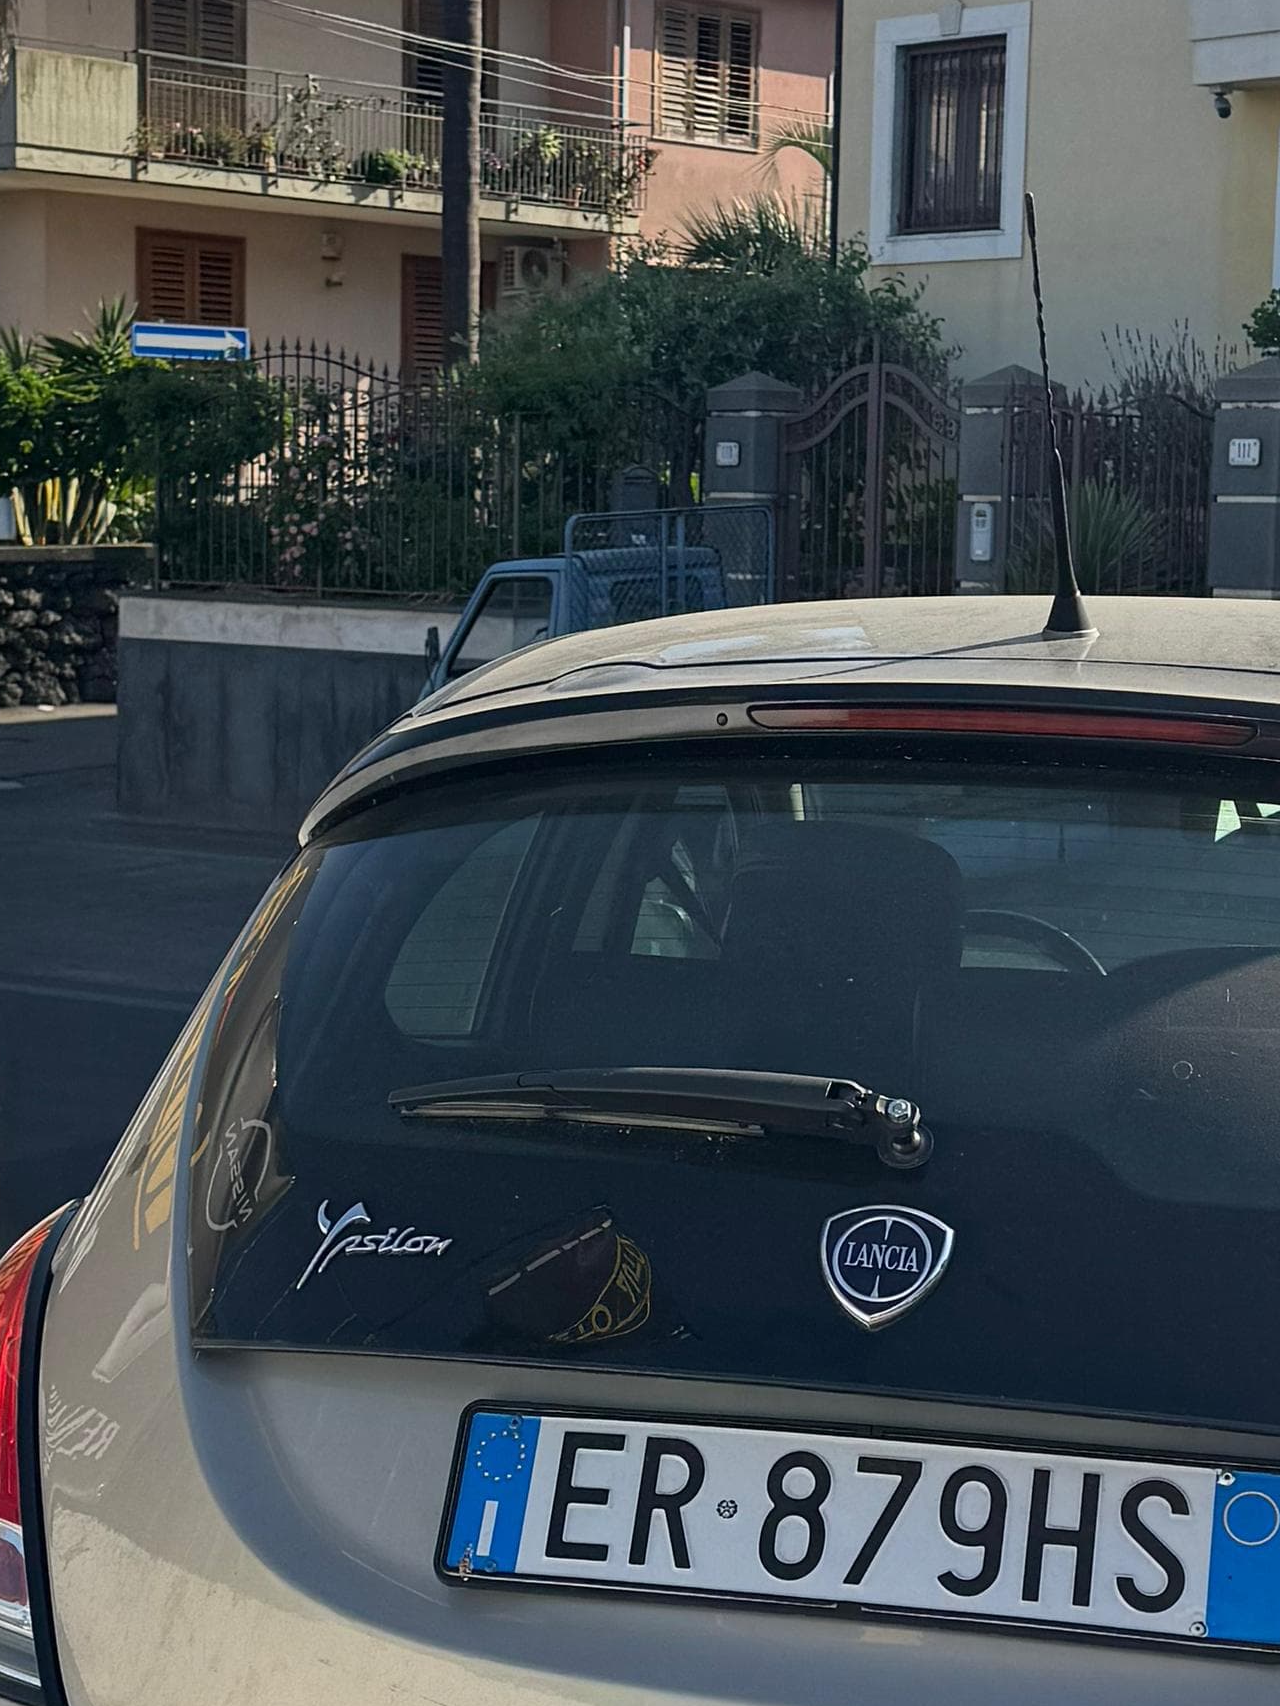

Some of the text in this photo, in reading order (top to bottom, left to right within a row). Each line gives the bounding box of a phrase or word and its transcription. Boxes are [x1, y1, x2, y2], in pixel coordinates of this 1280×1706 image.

[297, 1199, 454, 1290] Ypsilon
[844, 1241, 919, 1273] LANCIA
[544, 1430, 707, 1570] ER
[757, 1449, 1191, 1614] 879HS
